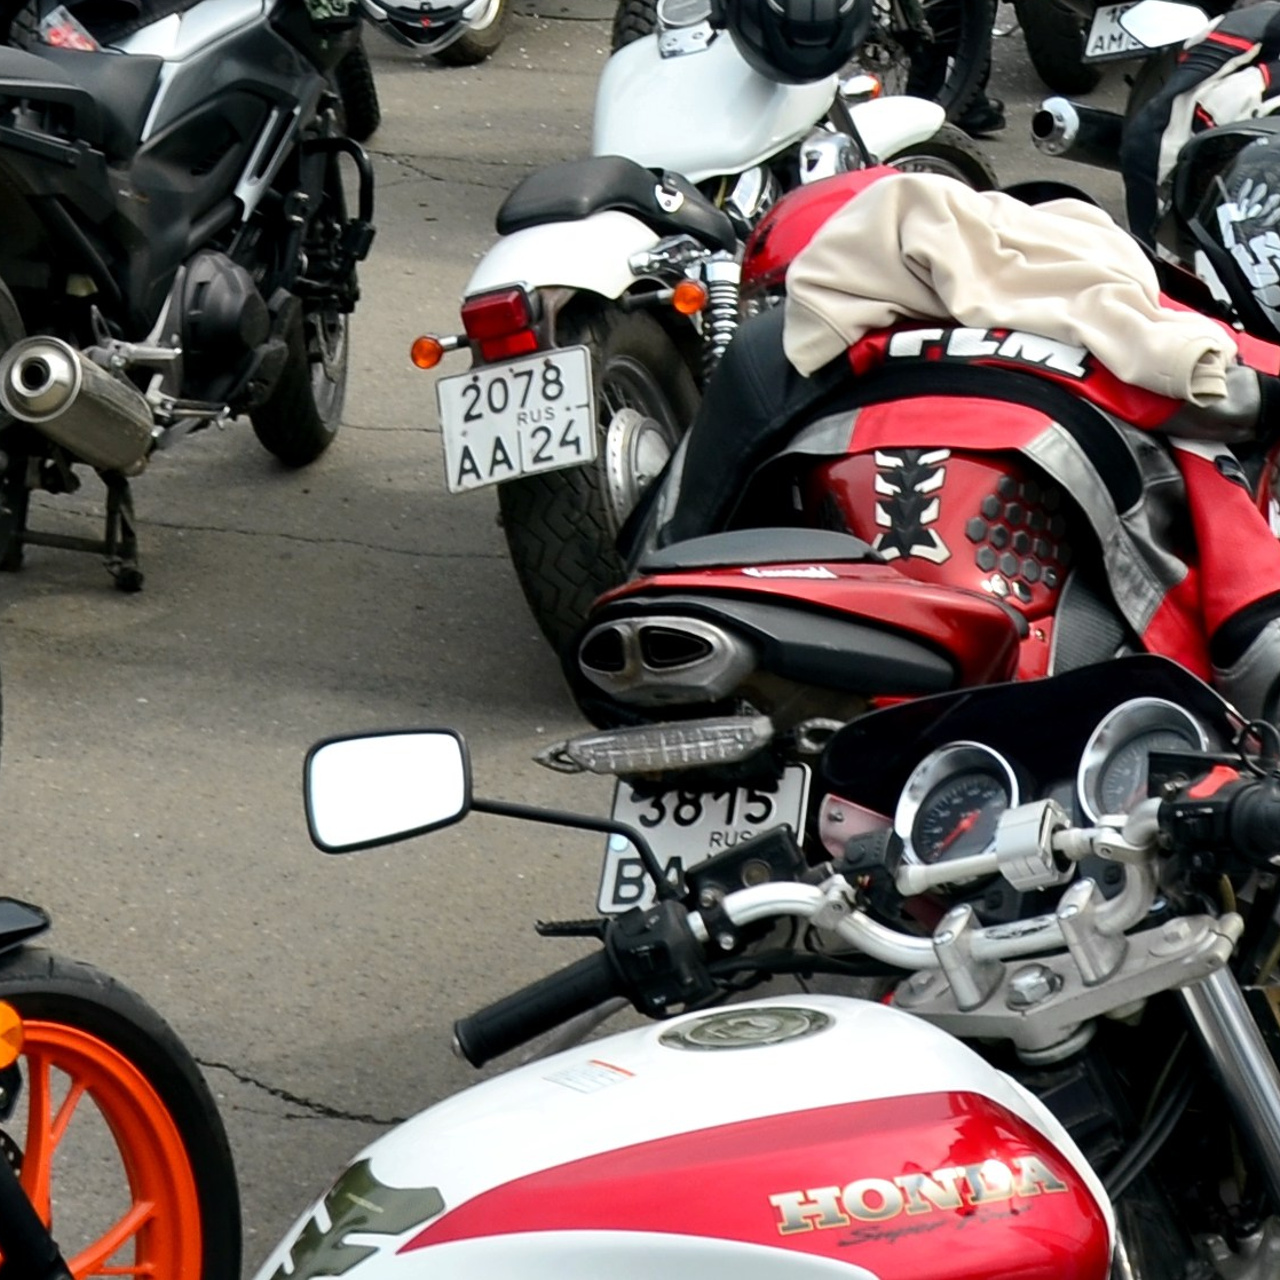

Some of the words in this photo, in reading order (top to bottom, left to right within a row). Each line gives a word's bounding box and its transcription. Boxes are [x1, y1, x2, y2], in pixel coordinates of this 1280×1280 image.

[462, 364, 564, 423] 2078
[516, 406, 556, 426] RUS
[457, 436, 514, 487] AA
[531, 419, 581, 465] 24
[636, 787, 774, 828] 3815
[768, 1155, 1068, 1235] HONDA
